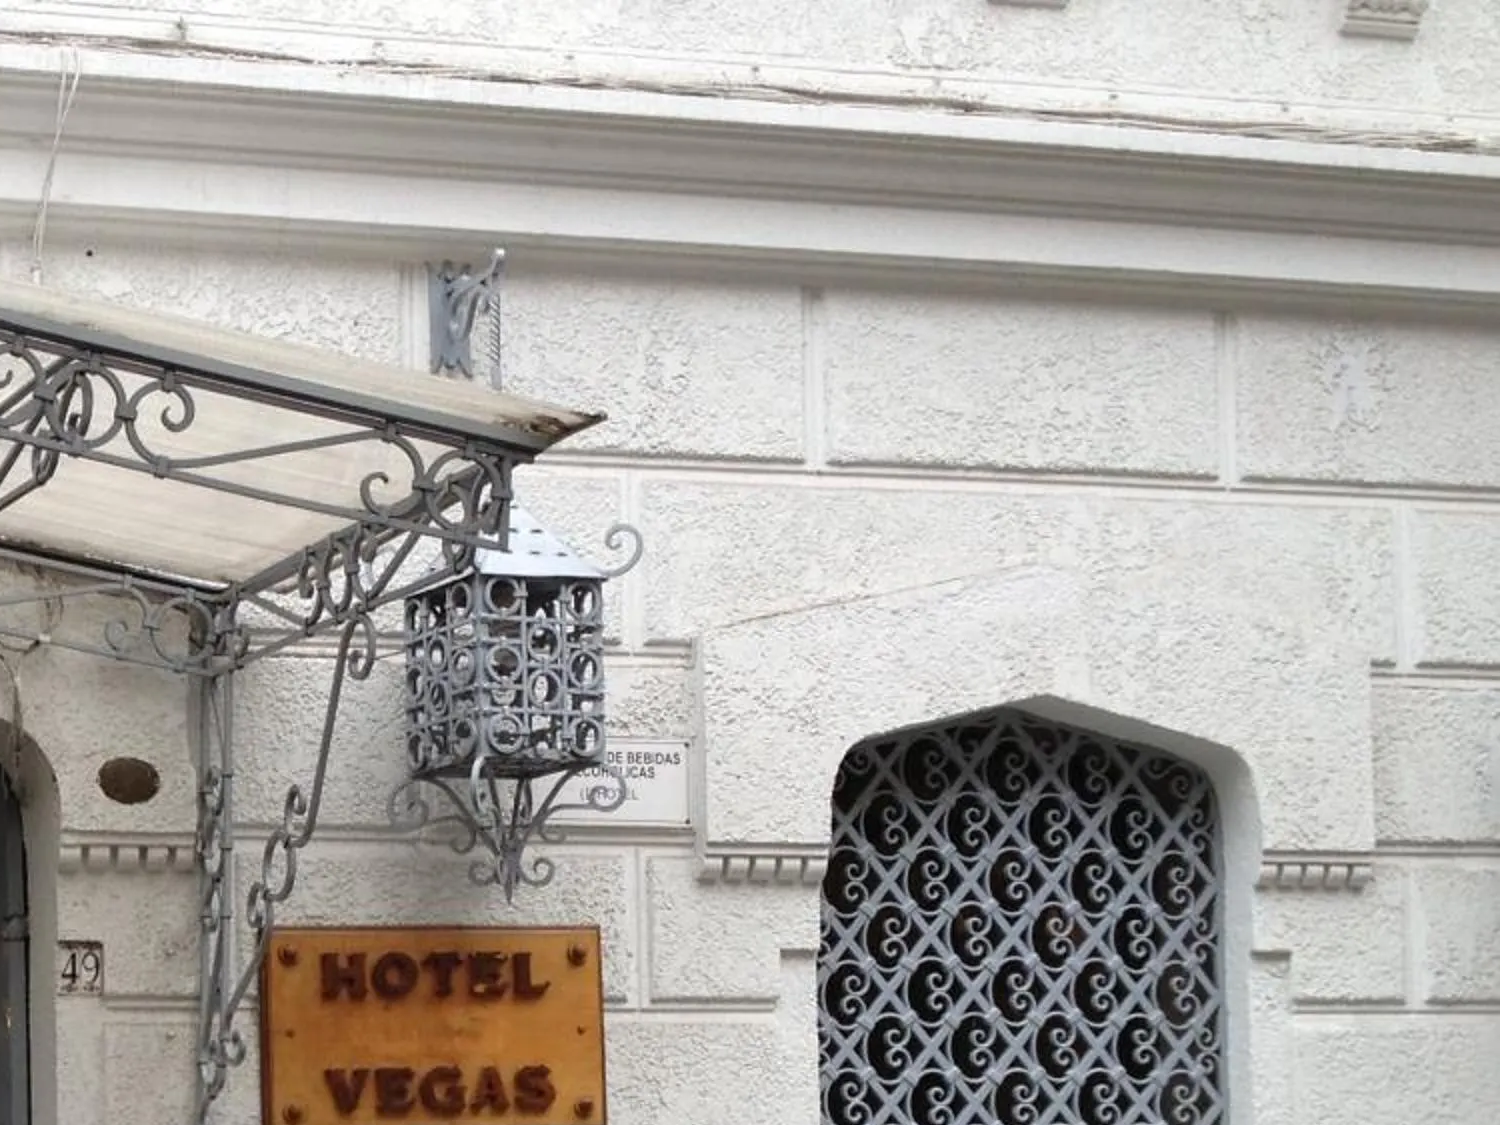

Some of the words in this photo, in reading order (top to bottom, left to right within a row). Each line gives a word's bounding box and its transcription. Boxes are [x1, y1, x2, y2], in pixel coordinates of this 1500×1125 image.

[627, 751, 681, 765] BEBIDAS
[61, 951, 100, 985] 49
[319, 951, 551, 1001] HOTEL
[323, 1064, 556, 1118] VEGAS
